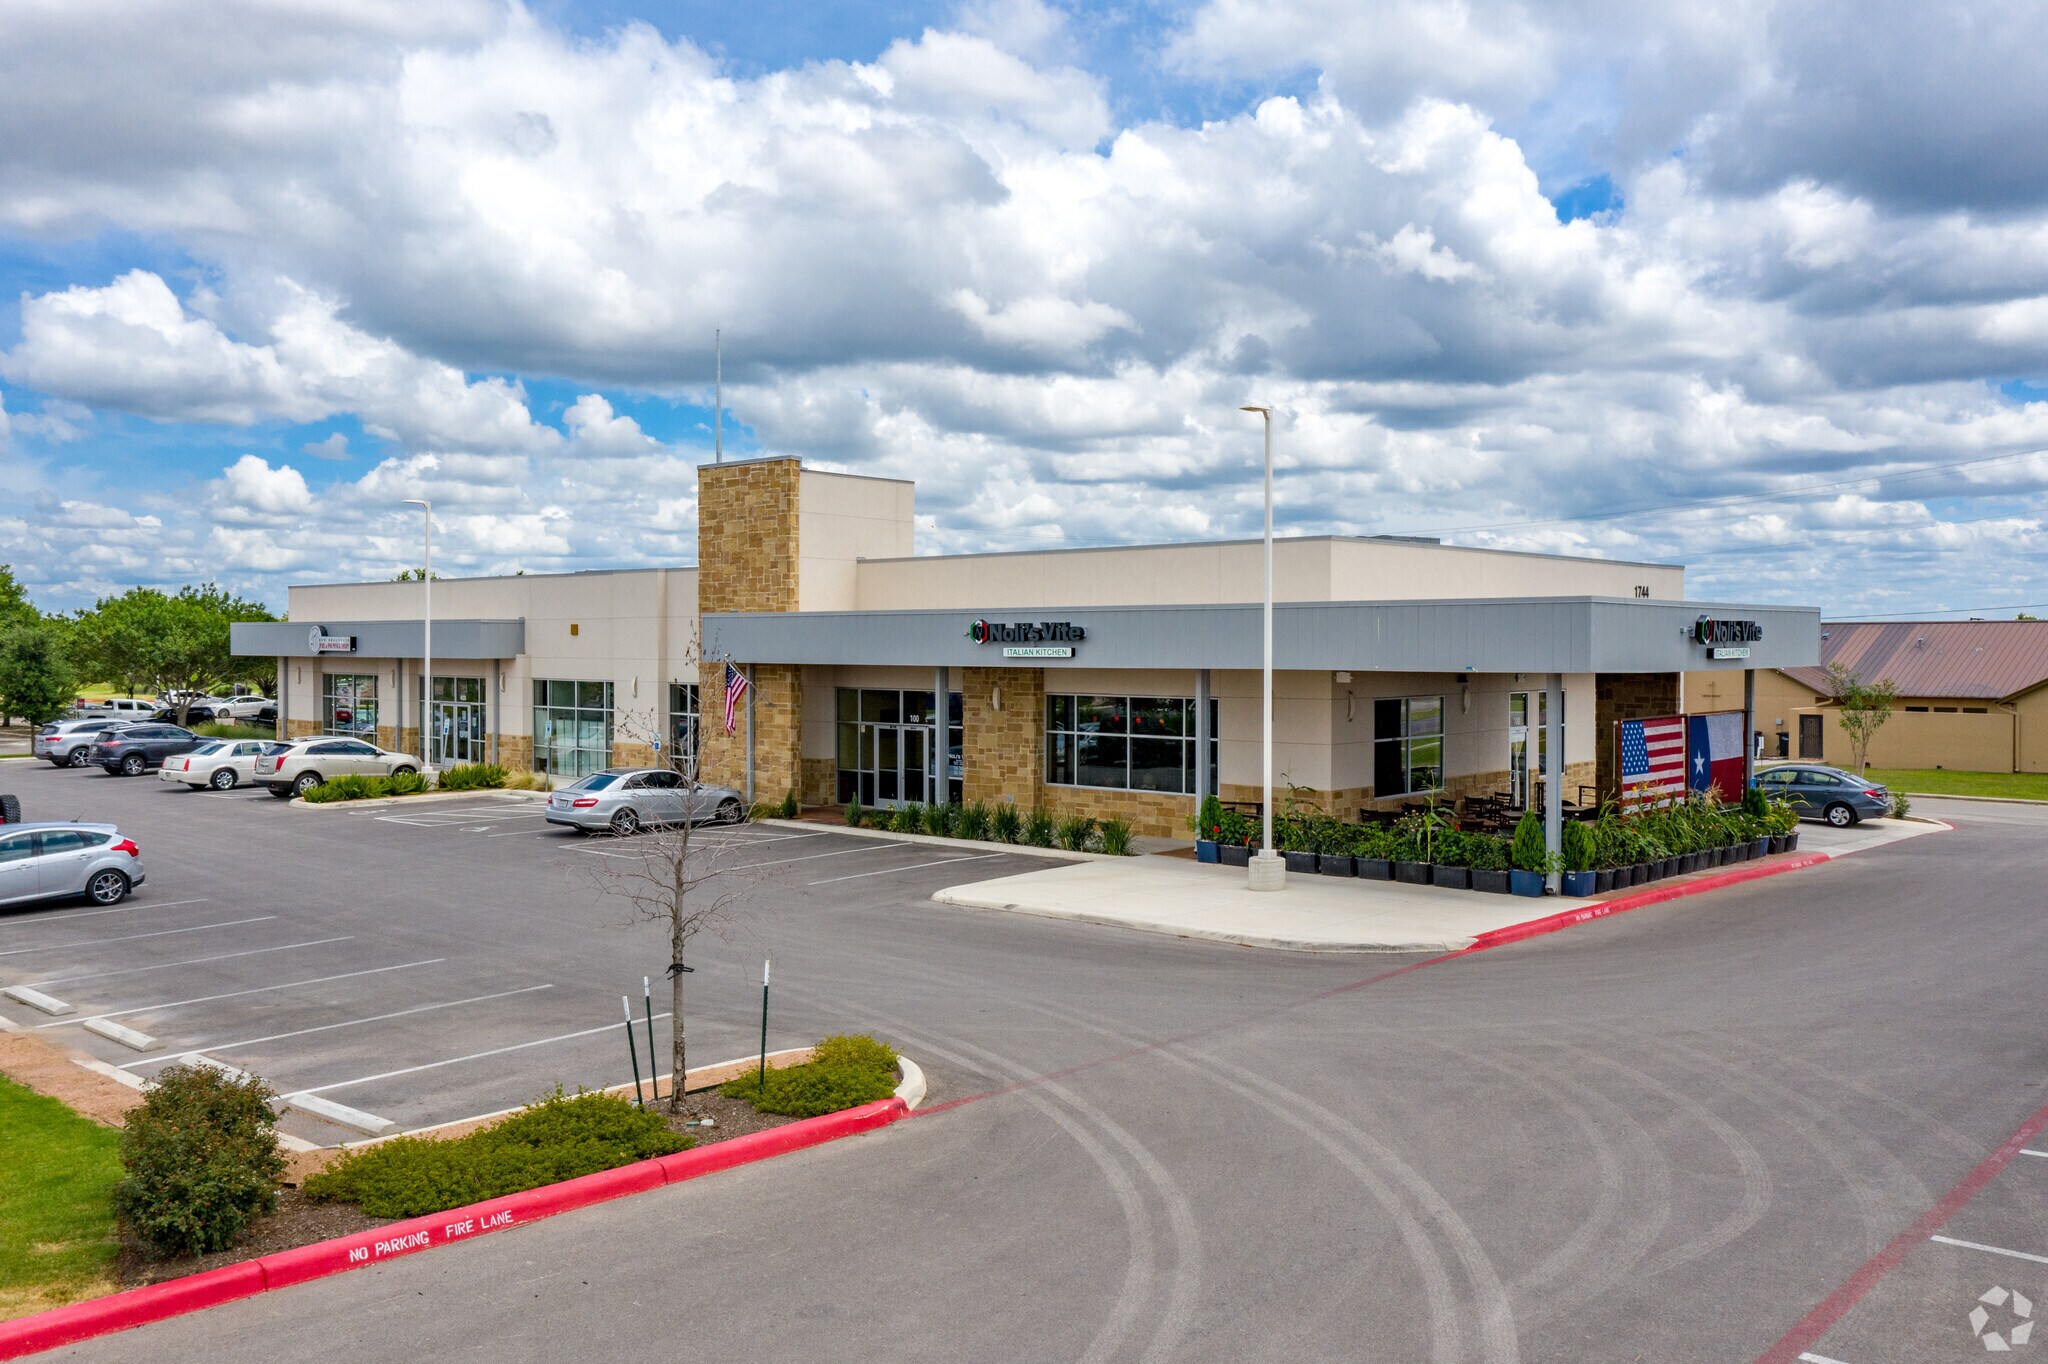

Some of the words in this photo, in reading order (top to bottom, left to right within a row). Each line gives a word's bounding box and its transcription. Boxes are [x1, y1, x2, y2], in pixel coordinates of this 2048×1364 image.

[1634, 585, 1649, 598] 1744
[988, 623, 1041, 641] Noli's
[1041, 622, 1085, 641] Vite
[1713, 621, 1741, 641] Noli's
[1742, 621, 1762, 641] Vite
[1007, 648, 1034, 656] ITALIAN
[1035, 648, 1067, 656] KITCHEN
[910, 714, 919, 722] 100
[349, 1247, 368, 1262] NO
[375, 1231, 429, 1257] PARKING
[446, 1220, 474, 1238] FIRE
[481, 1210, 513, 1229] LANE
